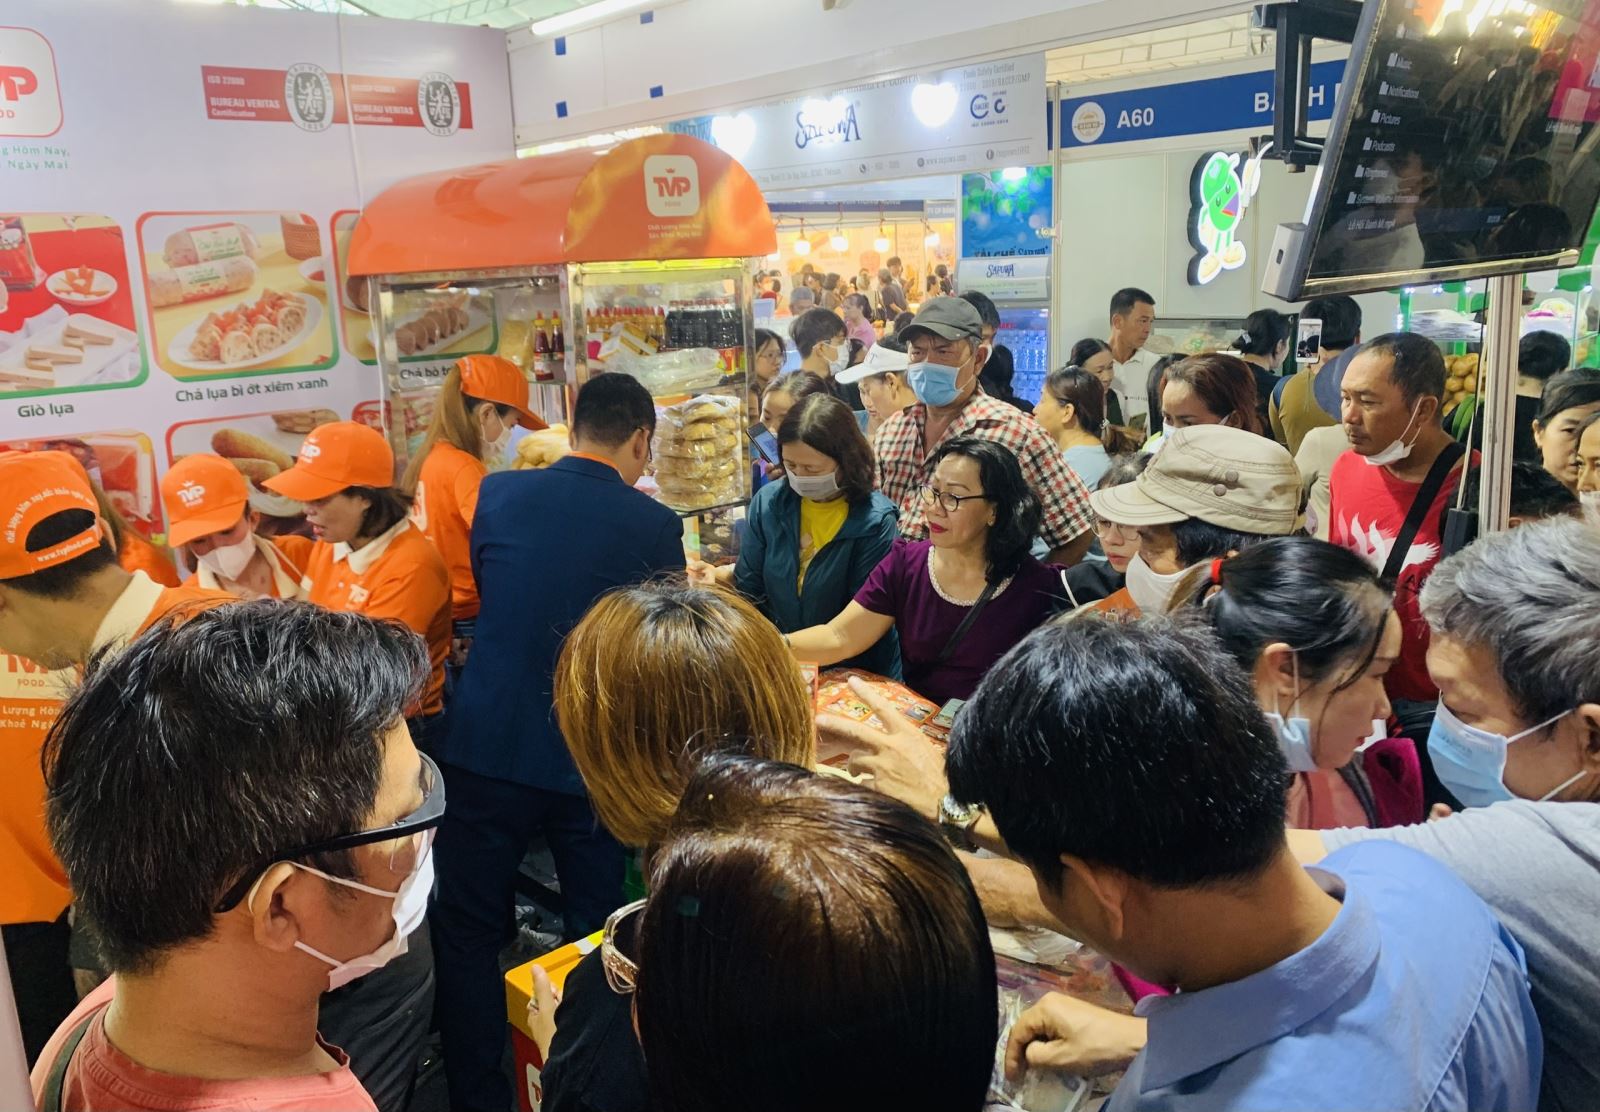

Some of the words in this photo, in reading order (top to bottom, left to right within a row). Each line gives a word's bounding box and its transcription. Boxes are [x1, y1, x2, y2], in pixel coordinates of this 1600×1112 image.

[1388, 86, 1420, 98] Notifications
[210, 97, 245, 108] BUREAU
[246, 98, 280, 109] VERITAS
[1254, 85, 1324, 114] BH
[212, 108, 256, 118] Certification
[352, 104, 384, 113] BUREAU
[384, 106, 414, 114] VERITAS
[1117, 108, 1154, 129] A60
[1380, 112, 1401, 125] Pictures
[1372, 140, 1396, 152] Podcasts
[8, 160, 39, 170] Ngày
[44, 160, 68, 169] Mai
[653, 176, 691, 198] TVP
[986, 264, 1015, 278] SAPUWA
[400, 368, 423, 380] Chả
[425, 366, 440, 377] bò
[176, 387, 204, 402] Chả
[207, 387, 228, 401] lụa
[232, 384, 244, 398] bì
[264, 381, 294, 393] xiêm
[296, 378, 328, 390] xanh
[18, 405, 45, 418] Giò
[50, 402, 74, 417] lụa
[176, 486, 206, 501] TVP
[17, 678, 45, 688] FOOD
[2, 706, 36, 717] Lượng
